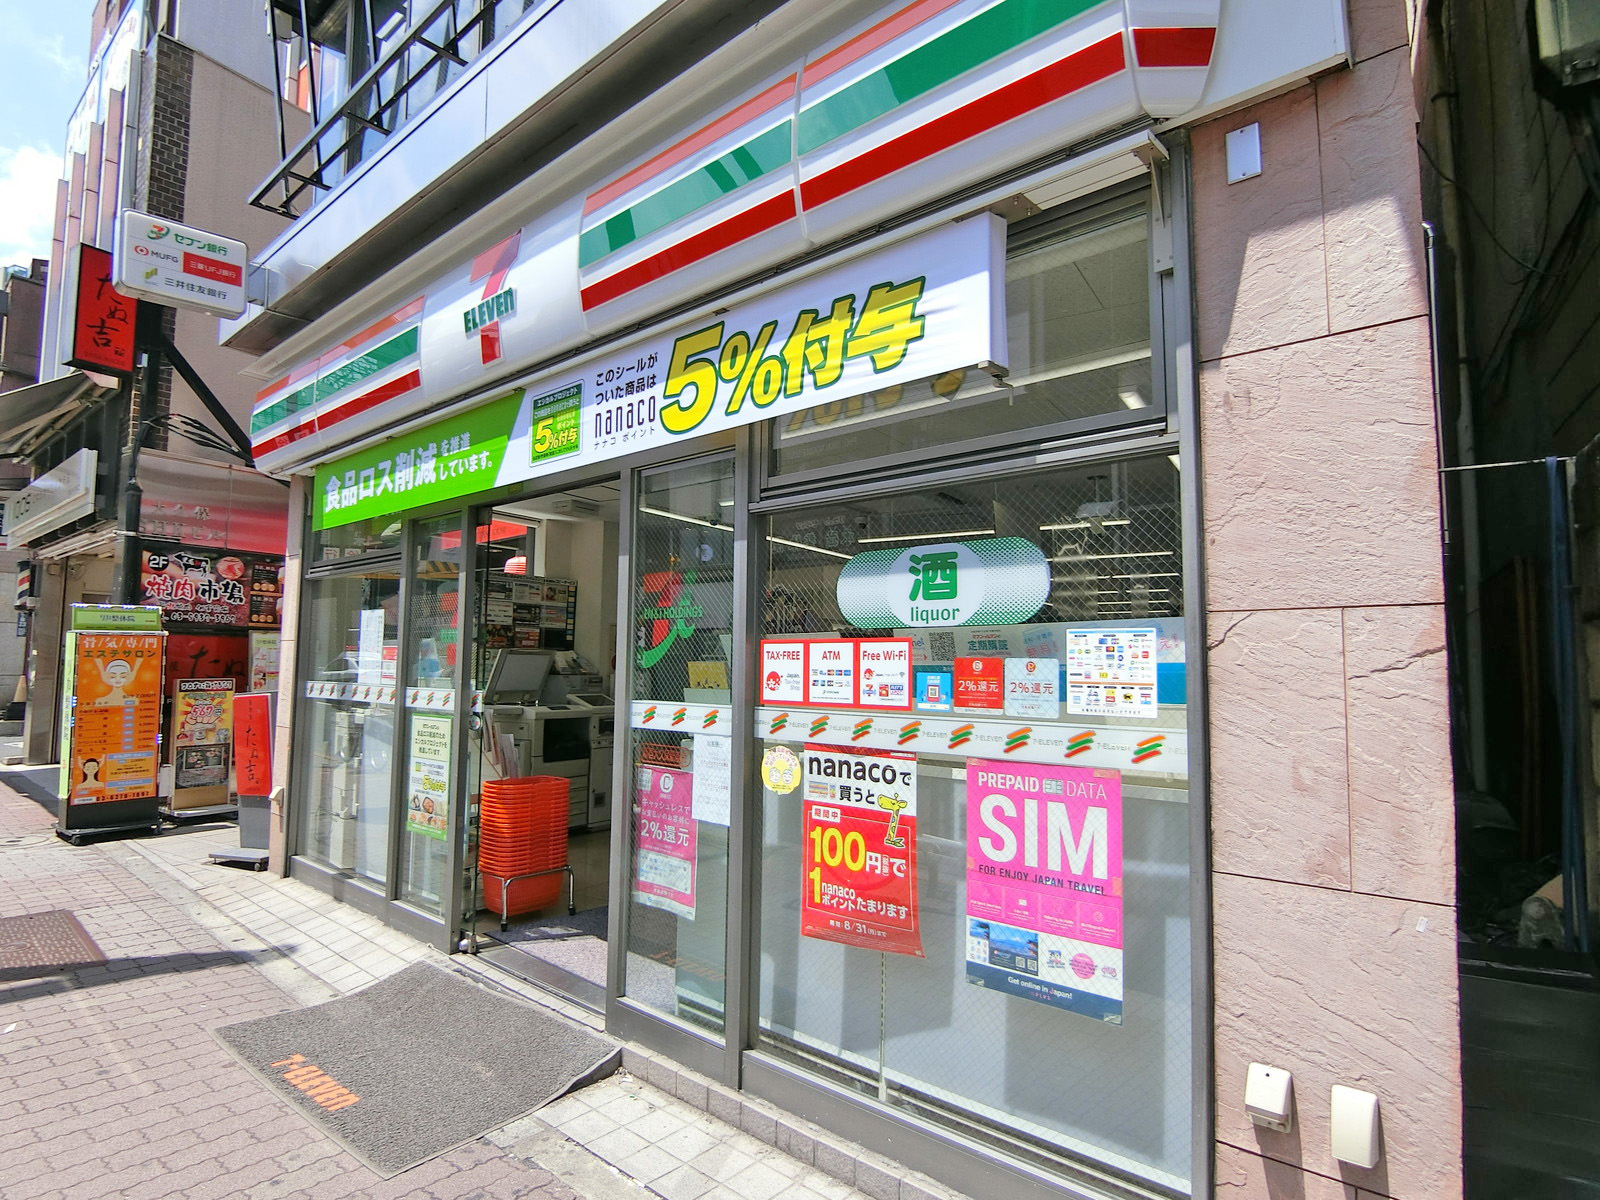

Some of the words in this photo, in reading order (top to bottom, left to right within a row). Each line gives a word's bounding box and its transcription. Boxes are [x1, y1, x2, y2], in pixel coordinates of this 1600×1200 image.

[173, 232, 228, 257] セブン銀行
[151, 251, 179, 264] MUFG
[164, 277, 228, 301] 三井住友銀行
[659, 275, 927, 435] 5%付与
[595, 352, 658, 387] このシールが
[595, 374, 657, 406] ついた商品は
[594, 396, 656, 439] nanaco
[440, 432, 471, 458] を推進
[534, 416, 578, 453] 5%付与
[593, 436, 617, 450] ナナコ
[622, 426, 656, 442] ポイント
[325, 443, 437, 513] 食品ロス削減
[439, 450, 494, 482] しています。
[149, 555, 168, 568] 2F
[908, 551, 958, 601] 酒
[146, 574, 245, 605] 焼肉市場
[910, 606, 960, 624] liquor
[83, 650, 156, 658] エステサロン
[766, 650, 800, 661] TAX-FREE
[821, 650, 841, 661] ATM
[862, 650, 881, 661] Free
[883, 650, 907, 661] Wi-Fi
[958, 680, 999, 693] 2%還元
[1010, 682, 1053, 694] 2%還元
[808, 756, 912, 786] nanacoで
[839, 785, 875, 805] 買うと
[978, 772, 1040, 792] PREPAID
[1066, 780, 1107, 800] DATA
[641, 797, 691, 815] キャッシュレスで
[641, 809, 690, 825] お支払いのお客様に
[814, 808, 839, 819] 期間中
[641, 819, 690, 847] 2%還元
[978, 794, 1108, 880] SIM
[809, 826, 881, 875] 100円
[890, 857, 907, 878] で
[821, 882, 856, 899] nanaco
[979, 864, 996, 876] FOR
[999, 866, 1029, 881] ENJOY
[1032, 874, 1064, 888] JAPAN
[1068, 880, 1106, 896] TRAVEL
[821, 895, 856, 912] ポイント
[856, 897, 908, 920] たまります
[1007, 976, 1020, 985] Get
[1020, 981, 1041, 992] online
[1041, 984, 1049, 993] in
[1049, 987, 1073, 1000] Japan!
